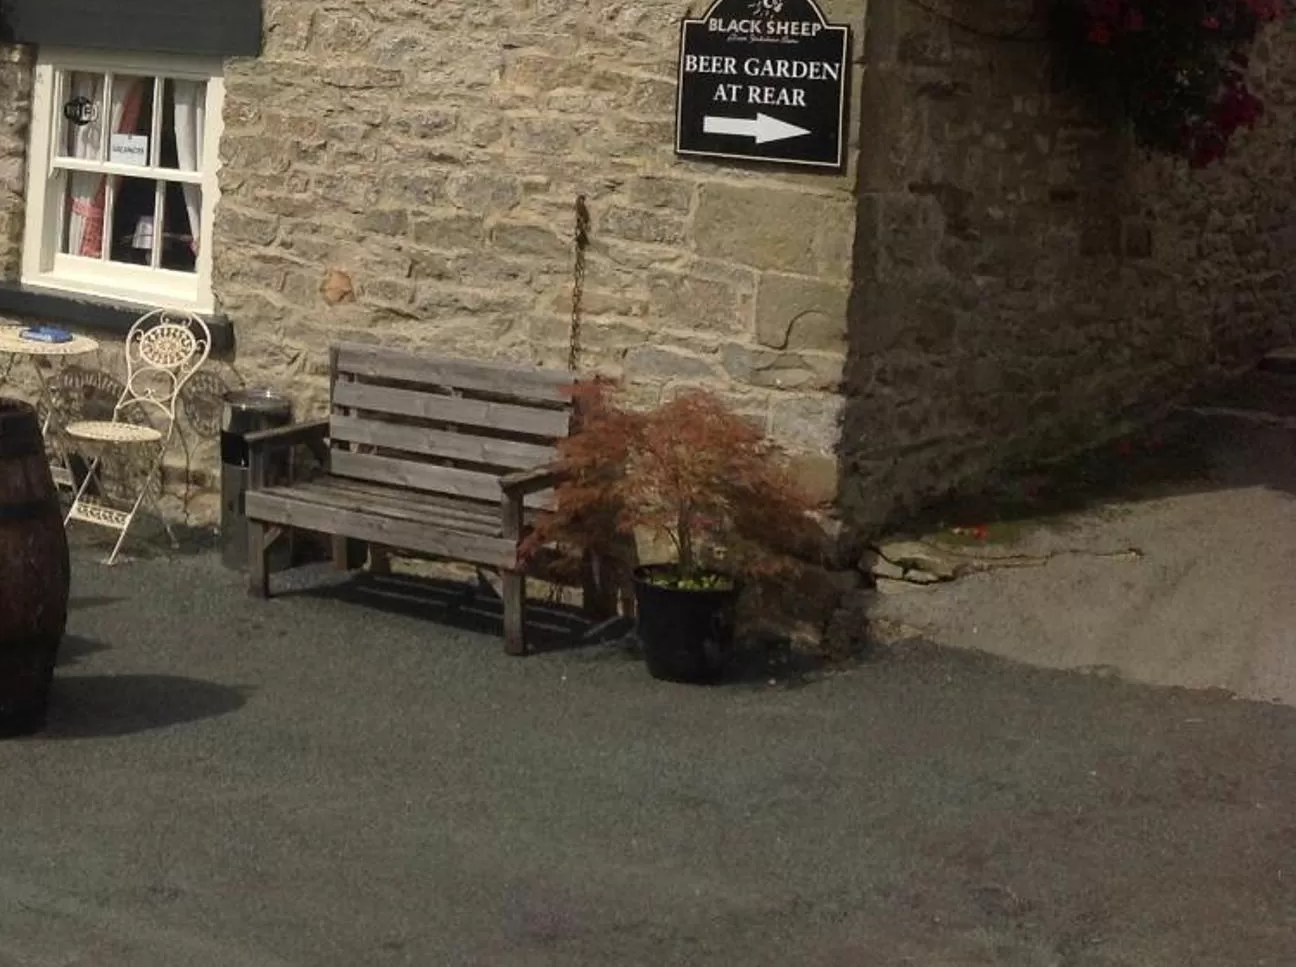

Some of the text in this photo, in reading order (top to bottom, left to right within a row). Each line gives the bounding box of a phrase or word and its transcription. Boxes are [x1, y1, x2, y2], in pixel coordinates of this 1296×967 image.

[708, 17, 821, 36] BLACK SHEEP
[685, 54, 841, 81] BEER GARDEN
[713, 83, 806, 107] AT REAR
